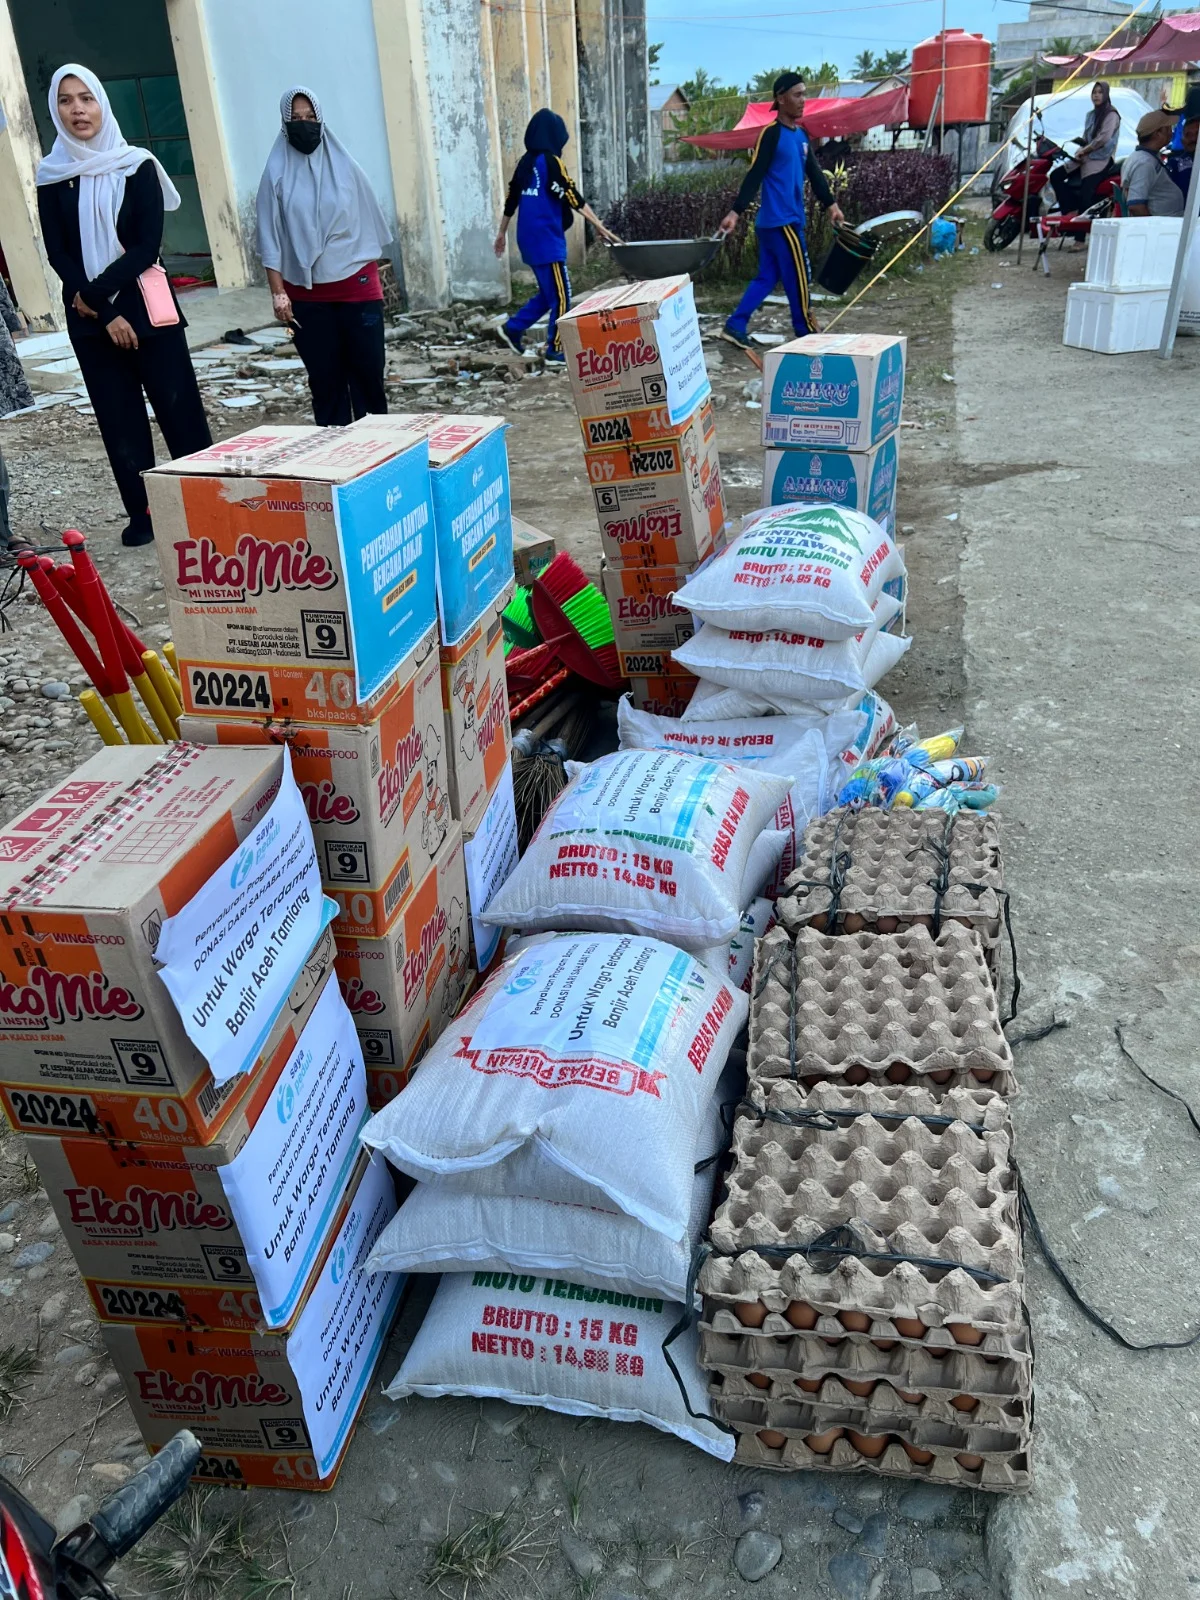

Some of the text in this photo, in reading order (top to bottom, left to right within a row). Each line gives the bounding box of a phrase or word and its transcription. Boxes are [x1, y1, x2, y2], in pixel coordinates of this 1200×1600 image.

[576, 337, 657, 379] EkoMie
[649, 382, 662, 397] 9
[589, 418, 632, 444] 20224
[590, 460, 615, 481] 40
[632, 449, 674, 473] 20224
[267, 500, 333, 512] WINGSFOOD
[606, 512, 683, 544] EkoMie
[173, 535, 333, 591] EkoMie
[737, 546, 849, 570] MUTU TERJAMIN
[743, 561, 832, 576] BRUTTO 15 KG
[190, 588, 241, 598] MI INSTAN
[734, 573, 831, 589] NETTO KG
[184, 606, 258, 615] RASA KALDU AYAM
[305, 612, 342, 620] TUMPUKAN
[260, 640, 278, 648] ALAM
[315, 624, 337, 650] 9
[728, 630, 764, 644] NETTO
[807, 634, 825, 649] KG
[192, 670, 271, 709] 20224
[304, 671, 354, 710] 40
[306, 707, 357, 721] bks/packs
[700, 735, 714, 745] 64
[732, 733, 774, 745] BERAS
[298, 749, 359, 760] WINGSFOOD
[624, 796, 643, 822] Untuk
[255, 817, 275, 845] saya
[338, 852, 358, 874] 9
[557, 844, 674, 876] BRUTTO 15 KG
[194, 820, 303, 947] Penyaluran Program Bantuan
[549, 862, 677, 898] NETTO KG
[193, 836, 306, 972] DONASI DARI SAHABAT PEDULI
[53, 933, 125, 946] WINGSFOOD
[192, 922, 260, 1029] Untuk Warga
[225, 887, 311, 1038] Banjir Aceh Tamiang
[530, 975, 554, 1016] Penyaluran
[601, 946, 657, 1029] Banjir Aceh Tamiang
[550, 988, 570, 1019] DONASI
[568, 999, 596, 1041] Untuk
[586, 970, 613, 1003] Warga
[365, 1038, 384, 1057] 9
[131, 1052, 157, 1076] 9
[289, 1048, 305, 1080] saya
[486, 1052, 621, 1086] BERAS PILIHAN
[11, 1091, 97, 1134] 20224
[134, 1097, 188, 1134] 40
[267, 1040, 339, 1185] Penyaluran Program Bantuan
[141, 1130, 195, 1144] bks/packs
[272, 1055, 342, 1207] DONASI DARI SAHABAT PEDULI
[152, 1160, 218, 1172] WINGSFOOD
[264, 1057, 356, 1261] Untuk Warga Terdampak
[284, 1096, 356, 1264] Banjir Aceh Tamiang
[63, 1186, 230, 1230] EkoMie
[97, 1227, 139, 1235] INSTAN
[343, 1211, 356, 1241] saya
[218, 1255, 242, 1275] 9
[320, 1236, 368, 1343] Penyaluran Program
[322, 1318, 342, 1363] DONASI
[481, 1304, 639, 1347] BRUTTO 15 KG
[315, 1298, 367, 1412] Untuk Warga
[331, 1313, 373, 1413] Banjir Aceh
[471, 1331, 644, 1377] NETTO KG
[133, 1370, 288, 1408] EkoMie
[274, 1427, 298, 1443] 9
[272, 1456, 318, 1480] 40
